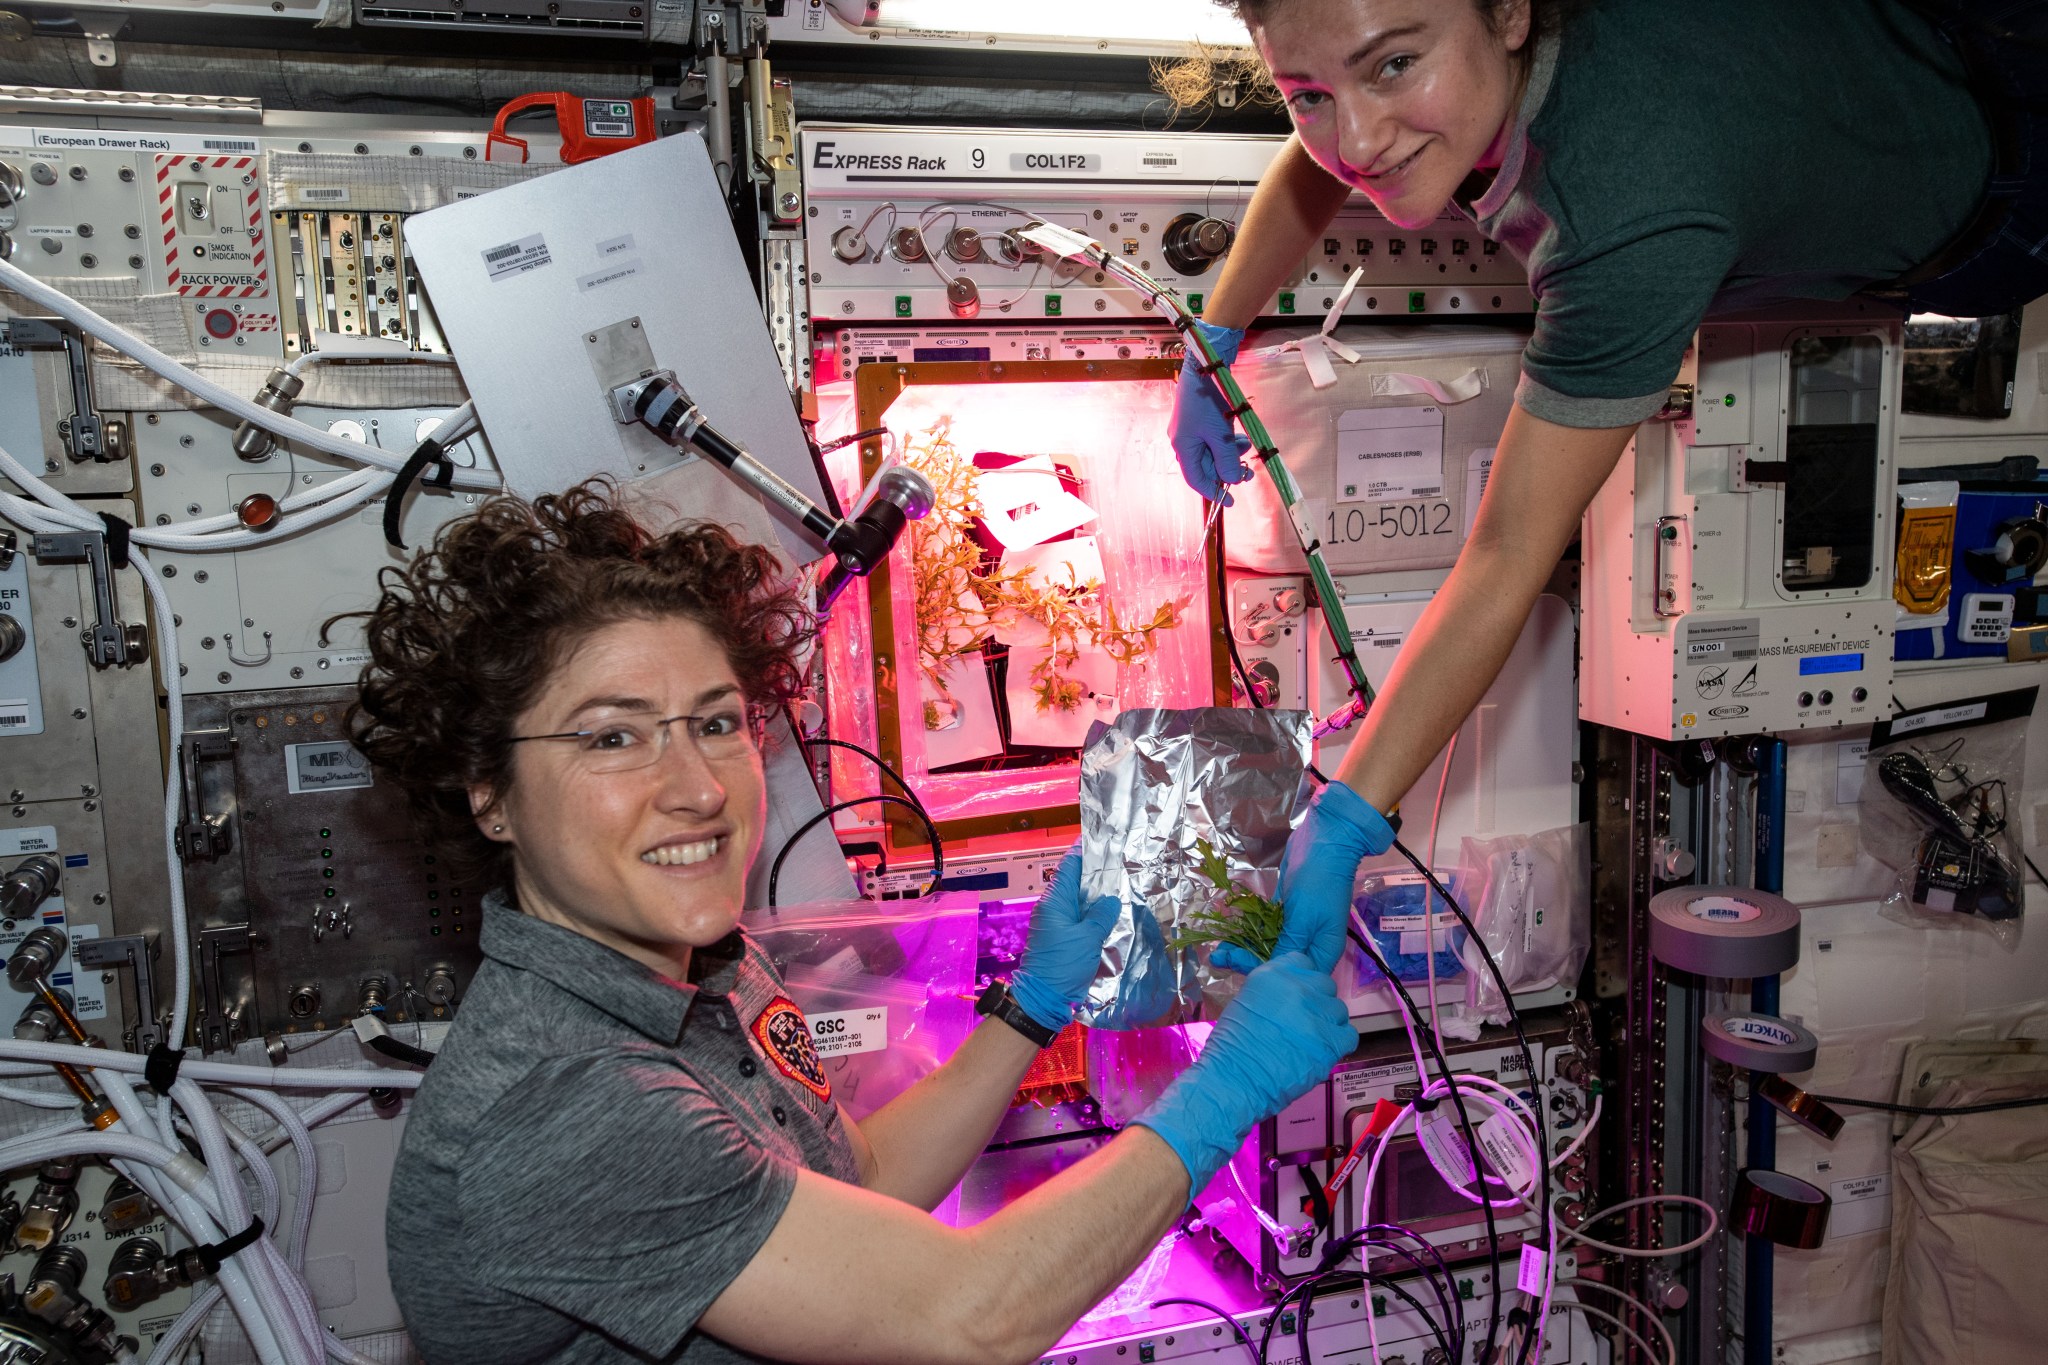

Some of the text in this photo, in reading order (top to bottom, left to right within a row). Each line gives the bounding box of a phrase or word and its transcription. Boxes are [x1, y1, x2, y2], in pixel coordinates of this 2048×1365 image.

[38, 135, 170, 150] (European Drawer Rack)
[813, 142, 985, 170] EXPRESS Rack 9
[1025, 154, 1086, 169] COL1F2
[220, 226, 234, 234] OFF
[211, 244, 235, 252] SMOKE
[211, 252, 251, 260] INDICATION
[520, 258, 552, 272] Laptop Desk
[181, 275, 253, 285] RACK POWER
[1358, 451, 1403, 460] CABLES/HOSES
[1327, 503, 1453, 545] 1.0-5012
[1692, 643, 1721, 652] S/N 001
[1759, 639, 1871, 657] MASS MEASUREMENT DEVICE
[1717, 707, 1741, 715] ORBITEC
[1816, 709, 1832, 717] ENTER
[1943, 711, 1964, 720] YELLOW
[1962, 708, 1974, 717] DOT
[309, 750, 351, 767] MFX
[301, 771, 367, 783] MagVector
[20, 838, 44, 846] WATER
[20, 843, 49, 851] RETURN
[1708, 908, 1740, 919] BERRY
[78, 999, 101, 1007] WATER
[79, 1005, 104, 1013] SUPPLY
[815, 1018, 845, 1035] GSC
[813, 1033, 862, 1045] EG46121657-301
[1500, 1054, 1526, 1065] MADE
[1344, 1064, 1413, 1081] Manufacturing Device
[62, 1231, 91, 1243] J314
[104, 1229, 136, 1241] DATA
[140, 1318, 174, 1328] EXTRACTION
